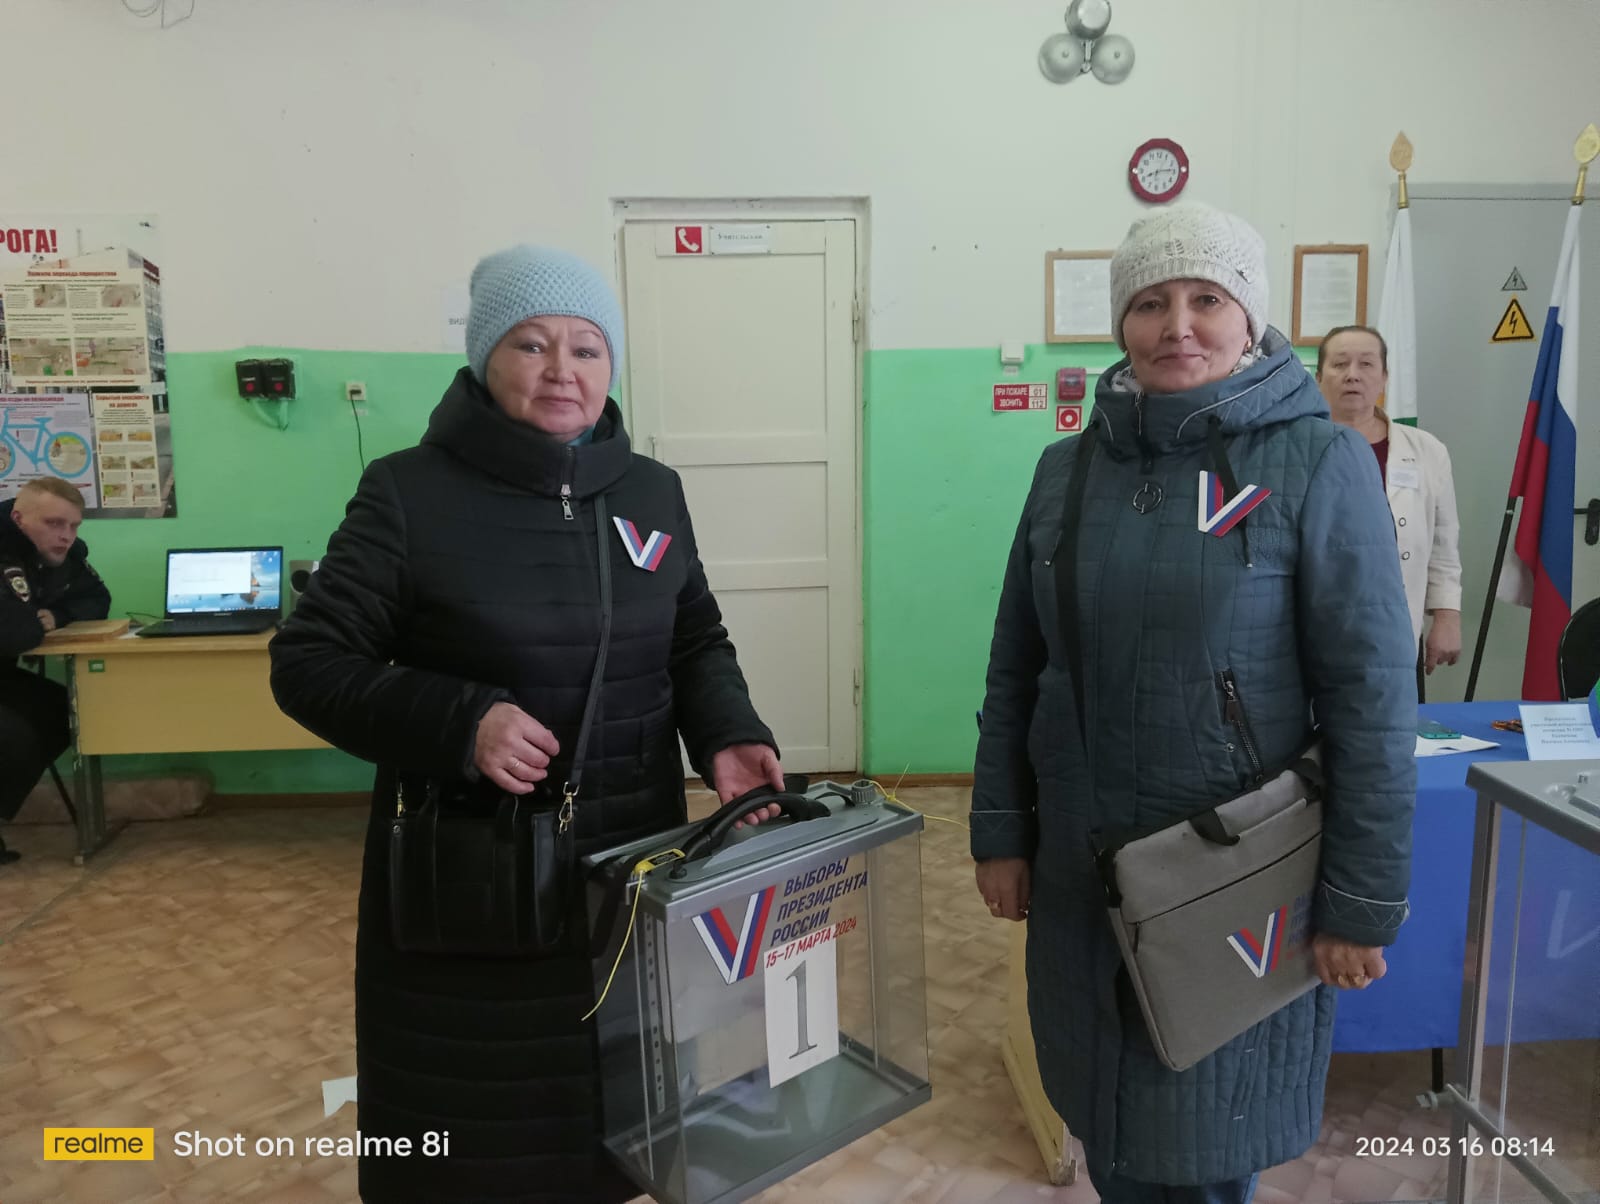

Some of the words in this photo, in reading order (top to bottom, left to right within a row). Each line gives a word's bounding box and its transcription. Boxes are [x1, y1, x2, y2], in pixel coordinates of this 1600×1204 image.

[777, 870, 868, 922] ПРЕЗИДЕНТА
[783, 857, 849, 897] ВЫБОРЫ
[771, 906, 830, 947] РОССИИ
[796, 927, 831, 955] МАРТА
[832, 916, 857, 938] 2024
[785, 959, 818, 1060] 1
